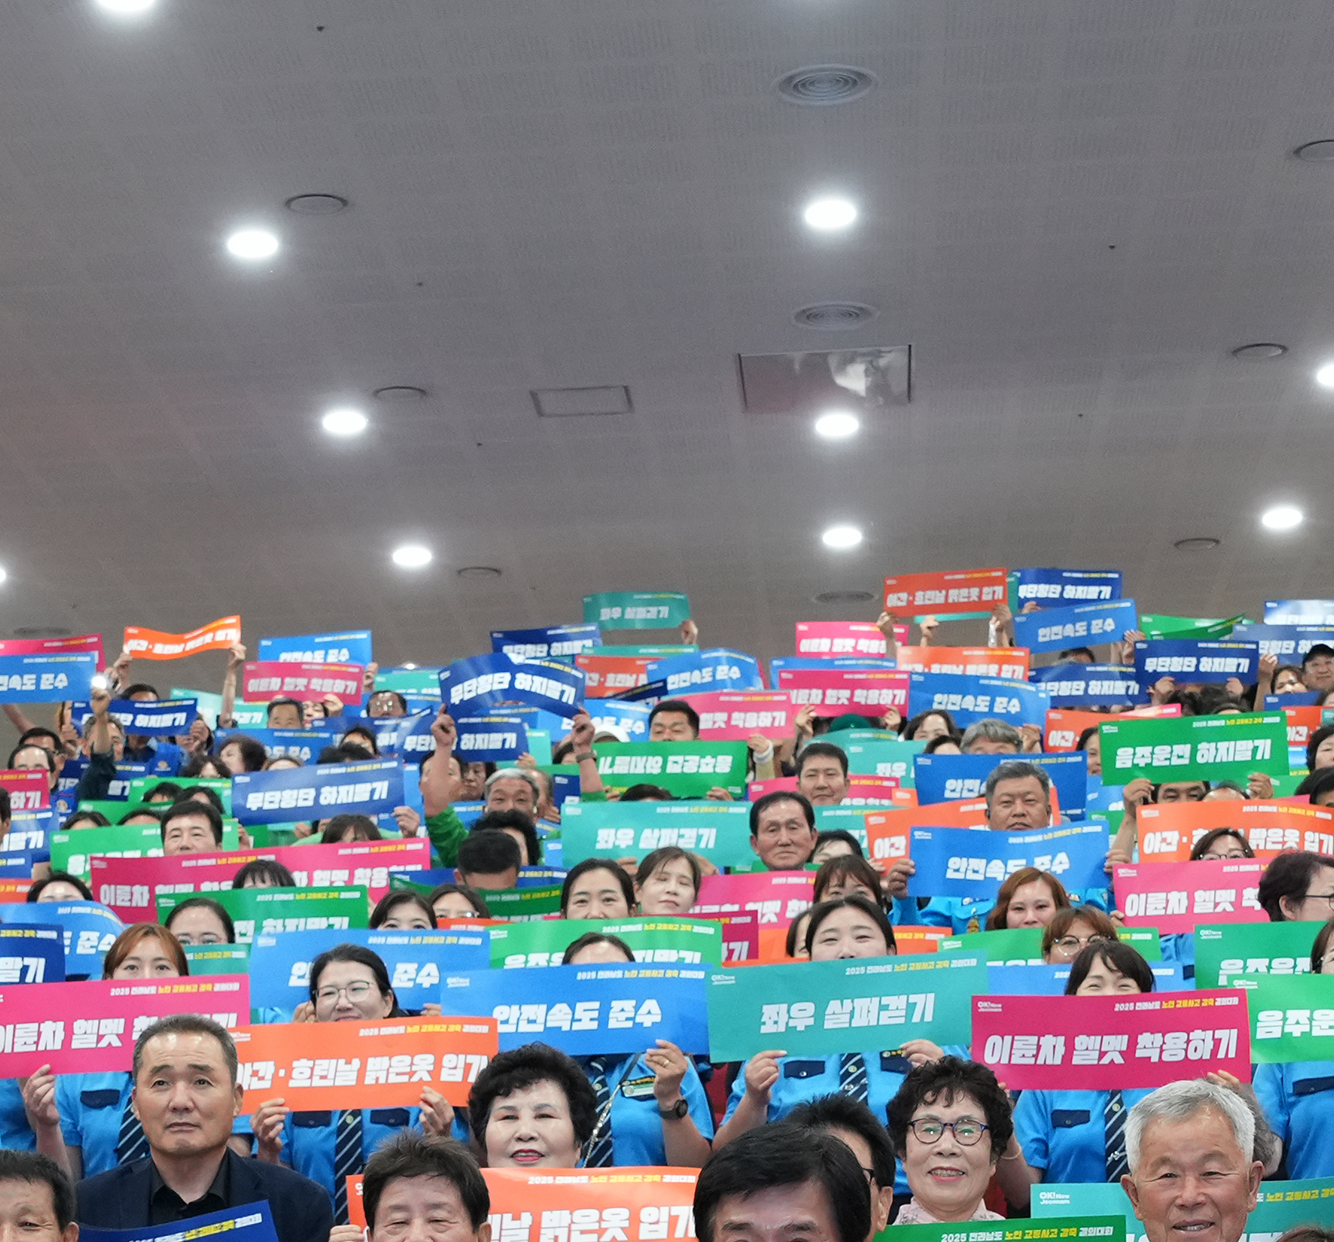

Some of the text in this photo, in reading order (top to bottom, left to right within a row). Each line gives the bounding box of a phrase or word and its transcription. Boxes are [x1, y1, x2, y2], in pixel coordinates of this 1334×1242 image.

[1116, 739, 1271, 769] 음주운전 하지말기
[246, 781, 388, 811] 무단횡단 하지말기
[595, 828, 717, 849] 좌우 살펴걷기
[1143, 830, 1178, 853] 야간
[1304, 830, 1334, 855] 입기
[1125, 889, 1236, 916] 이륜차 헬멧
[391, 962, 440, 987] 준수
[492, 998, 662, 1033] 안전속도 준수
[760, 993, 934, 1034] 좌우 살펴걷기
[72, 1018, 125, 1049] 헬멧
[984, 1029, 1238, 1065] 이륜차 헬멧 착용하기
[288, 1053, 492, 1088] 흐린날 밝은옷 입기
[941, 1227, 1113, 1242] 2025 전라남도 노인 교통사고 감축 결의대회
